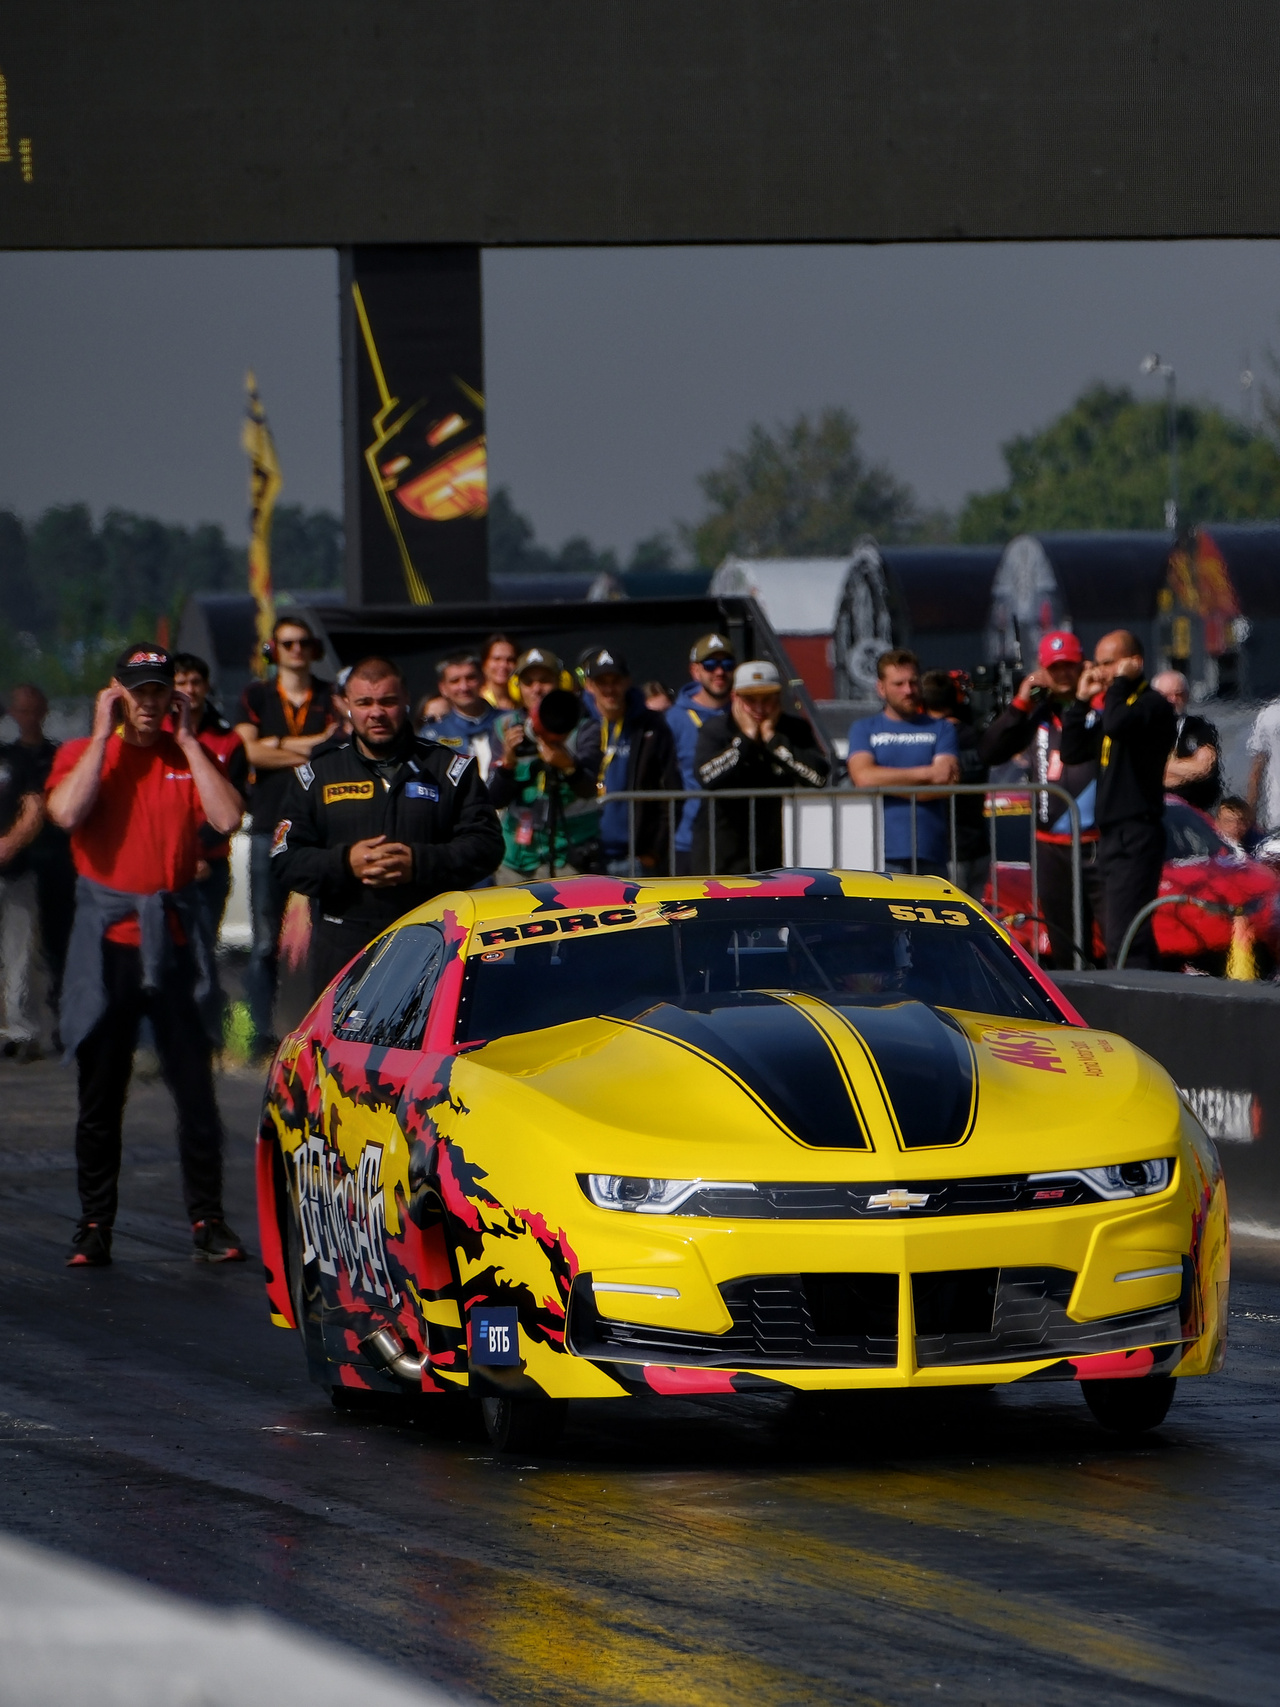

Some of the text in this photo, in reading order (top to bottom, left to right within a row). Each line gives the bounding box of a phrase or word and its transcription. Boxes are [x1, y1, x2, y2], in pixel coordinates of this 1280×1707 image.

[888, 905, 970, 926] 513
[477, 909, 637, 946] RDRC
[1033, 1190, 1065, 1199] SS
[489, 1326, 510, 1352] ВТБ
